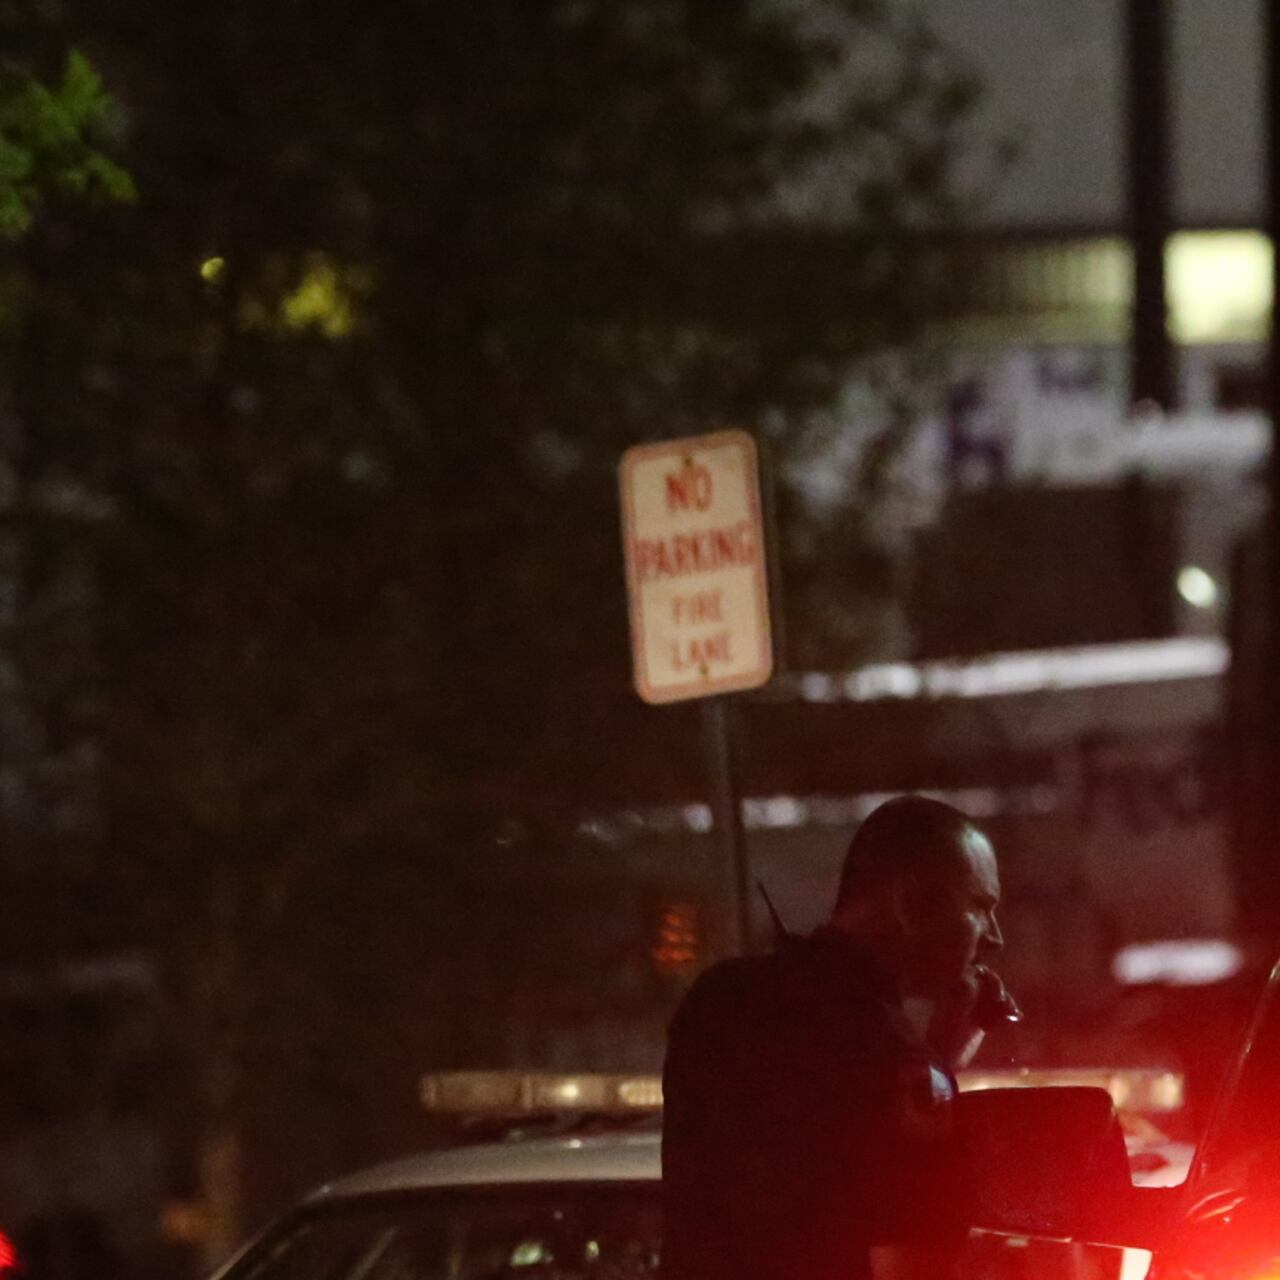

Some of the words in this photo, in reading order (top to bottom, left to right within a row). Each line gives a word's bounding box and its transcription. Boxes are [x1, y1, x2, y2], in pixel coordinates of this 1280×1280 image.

[665, 464, 713, 512] NO
[634, 521, 757, 579] PARKING
[675, 592, 723, 624] FIRE
[673, 634, 733, 671] LANE
